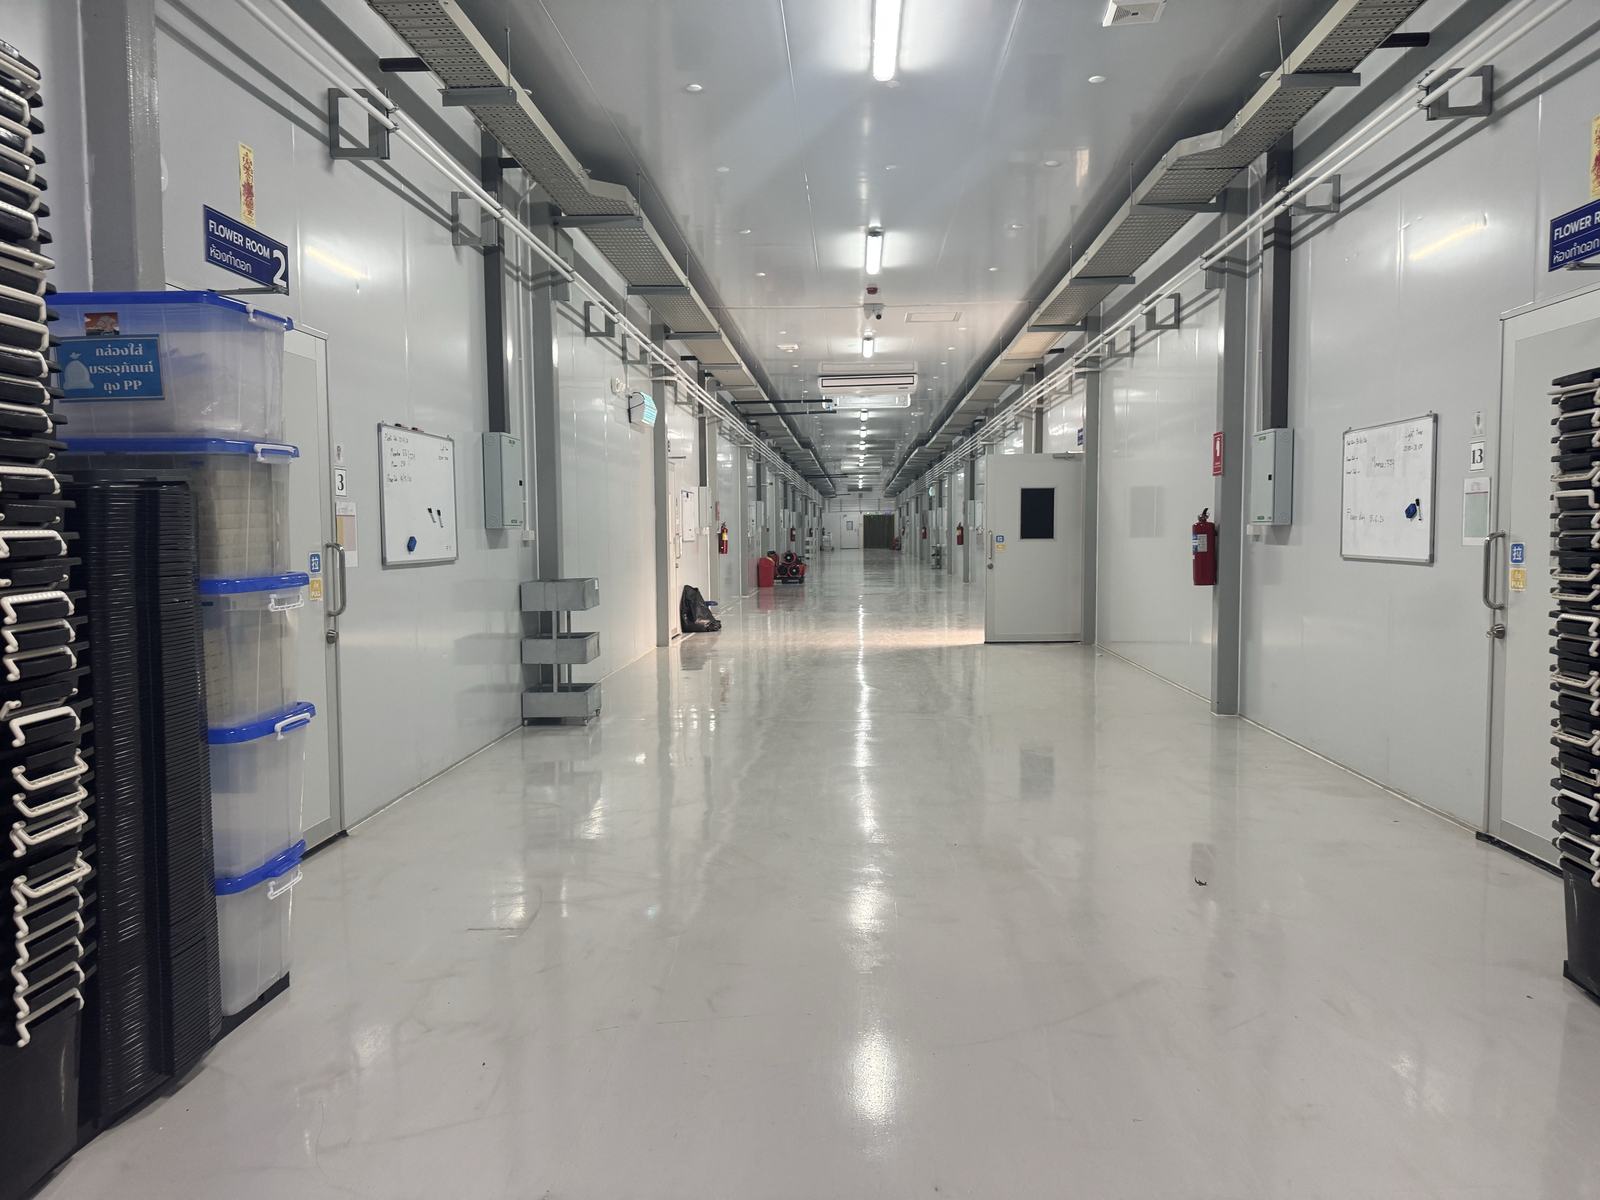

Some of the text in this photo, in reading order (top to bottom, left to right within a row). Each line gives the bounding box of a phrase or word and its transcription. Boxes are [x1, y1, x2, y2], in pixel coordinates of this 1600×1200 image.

[1553, 214, 1592, 241] FLOWER
[208, 219, 287, 288] FLOWER ROOM 2
[209, 243, 252, 274] ห้องทำดอก
[1552, 238, 1600, 264] ห้องทำดอก
[95, 342, 143, 357] กล่องใส่
[89, 360, 154, 377] บรรจุภัณฑ์
[103, 379, 143, 394] ถุง PP
[1471, 448, 1483, 465] 13
[337, 473, 345, 491] 3
